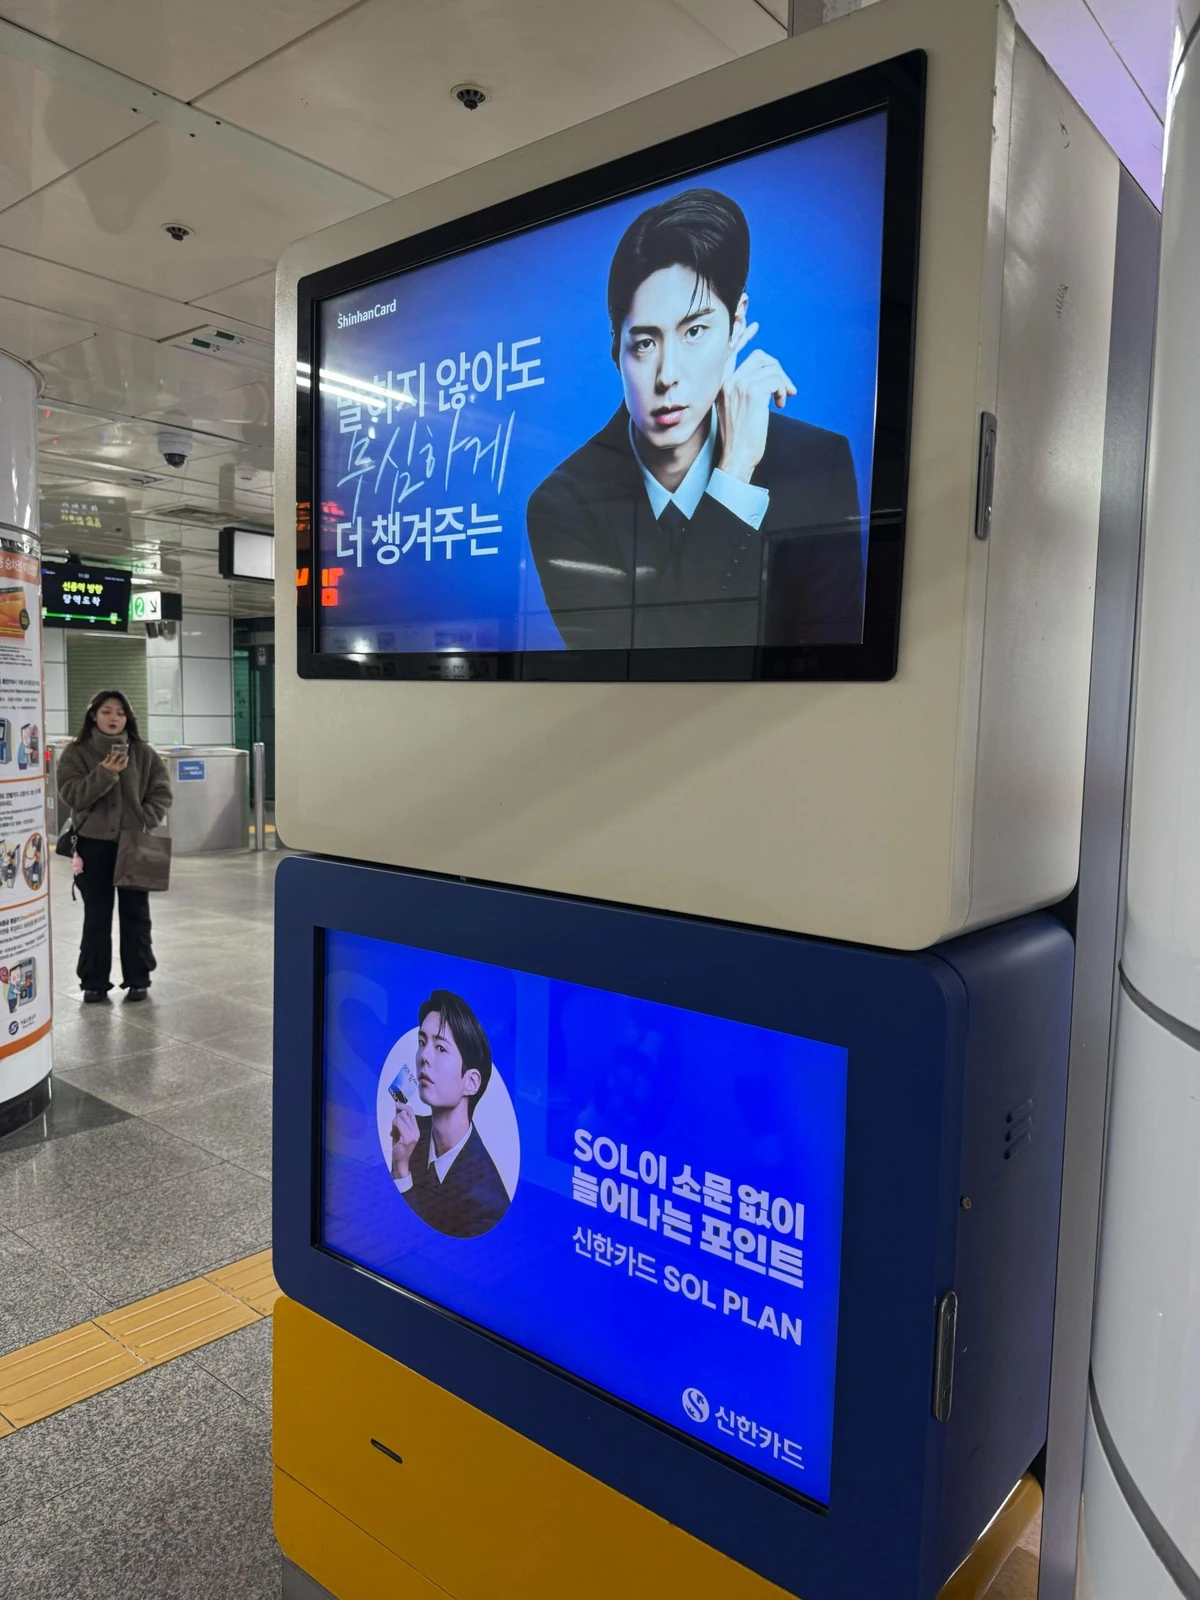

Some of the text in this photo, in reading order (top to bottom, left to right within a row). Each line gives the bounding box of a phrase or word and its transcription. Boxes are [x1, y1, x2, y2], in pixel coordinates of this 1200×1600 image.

[337, 299, 397, 329] ShinhanCard
[436, 336, 545, 413] 않아도
[336, 408, 516, 524] 무심하게
[336, 516, 362, 568] 더
[371, 503, 503, 565] 챙겨주는
[136, 597, 145, 617] 2
[573, 1128, 805, 1241] SOL이 소문 없이
[572, 1165, 804, 1290] 늘어나는 포인트
[572, 1226, 803, 1347] 신한카드 SOL PLAN
[714, 1405, 805, 1470] 신한카드
